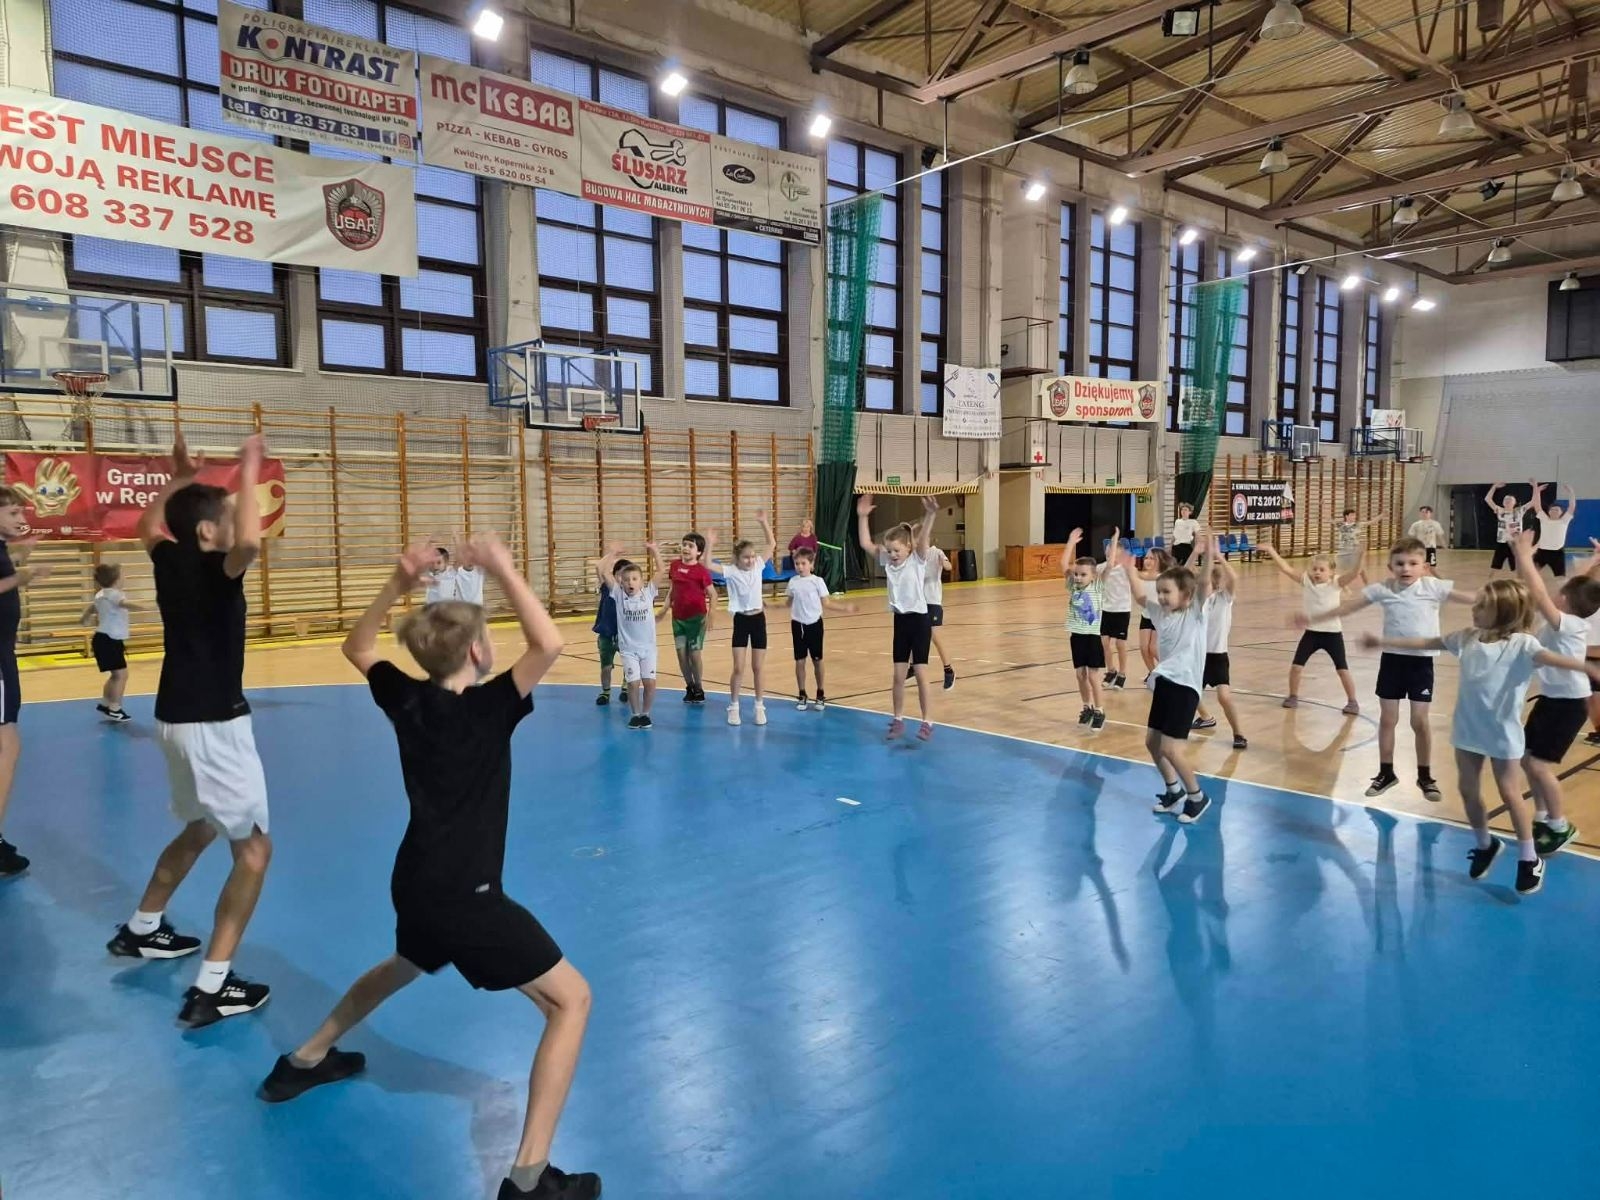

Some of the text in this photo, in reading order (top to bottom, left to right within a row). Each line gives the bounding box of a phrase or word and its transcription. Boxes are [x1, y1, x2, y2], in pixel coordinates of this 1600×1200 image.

[237, 25, 400, 83] KONTRAST
[230, 58, 408, 114] DRUK FOTOTAPET
[227, 98, 255, 115] tel.
[260, 106, 288, 121] 601
[294, 113, 313, 127] 23
[318, 119, 337, 132] 57
[341, 123, 359, 137] 83
[0, 104, 275, 183] EST MIEJSCE
[436, 121, 472, 137] PIZZA
[483, 130, 521, 148] KEBAB
[531, 143, 569, 160] GYROS
[464, 160, 547, 186] tel. 55 620 05 54
[494, 155, 535, 172] Kopernika
[537, 165, 548, 174] 25
[611, 148, 688, 187] ŚLUSARZ
[117, 165, 276, 218] REKLAMĘ
[585, 184, 623, 202] BUDOWA
[625, 192, 642, 205] HAL
[643, 195, 711, 220] MAGAZYNOWYCH
[653, 180, 688, 195] ALBRECHT
[10, 183, 255, 244] 608 337 528
[334, 211, 377, 234] USAR
[1074, 380, 1134, 403] Dziękujemy
[1075, 404, 1133, 419] sponsorom
[96, 491, 114, 504] w
